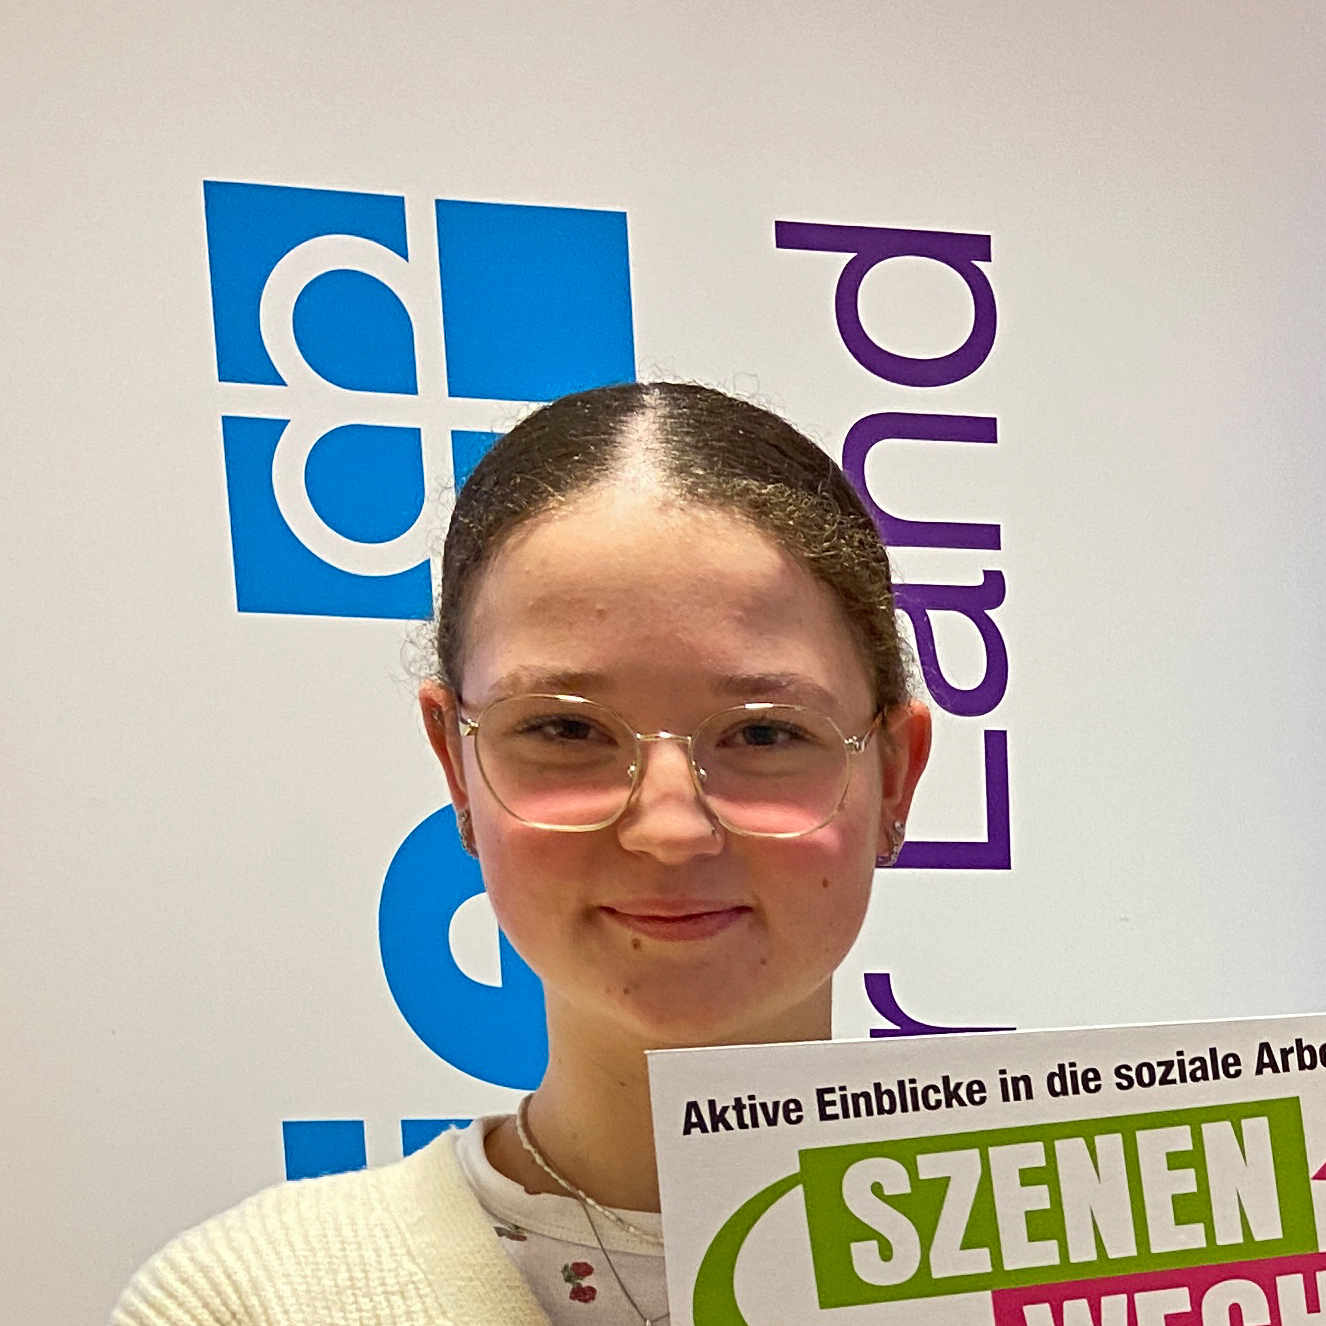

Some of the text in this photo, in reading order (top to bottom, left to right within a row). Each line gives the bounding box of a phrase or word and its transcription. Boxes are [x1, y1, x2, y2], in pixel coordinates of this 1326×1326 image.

[682, 1094, 804, 1136] Aktive
[816, 1075, 987, 1122] Einblicke
[999, 1069, 1034, 1102] in
[1046, 1061, 1102, 1098] die
[1114, 1047, 1242, 1090] soziale
[841, 1116, 1284, 1288] SZENEN
